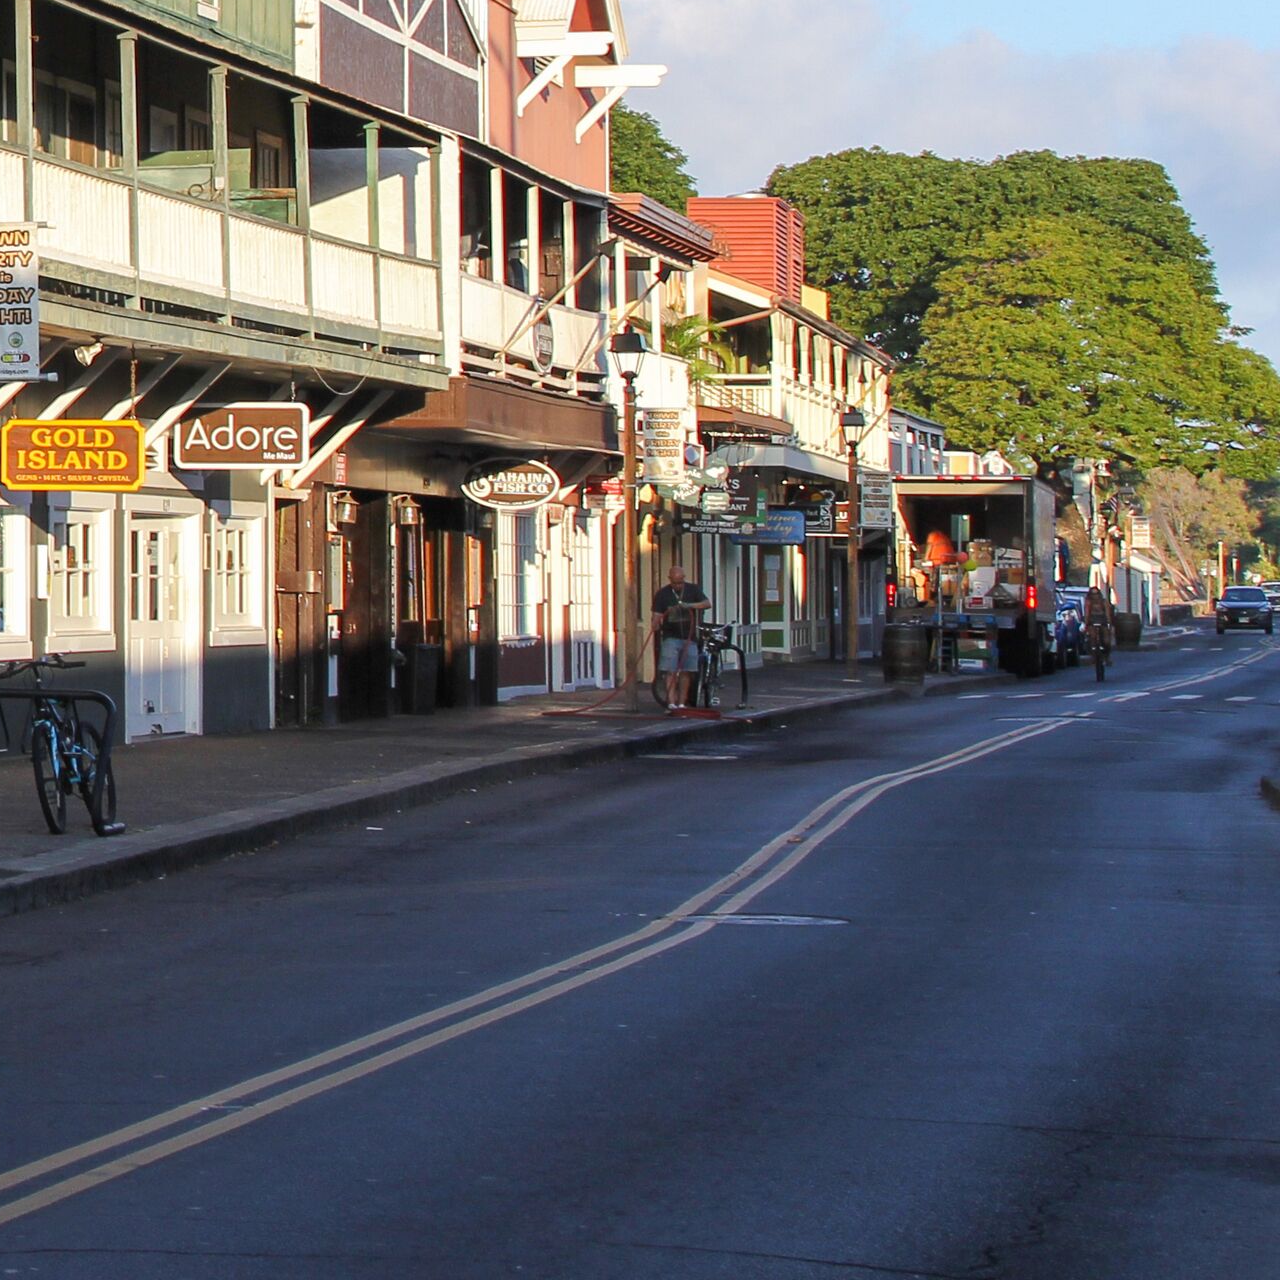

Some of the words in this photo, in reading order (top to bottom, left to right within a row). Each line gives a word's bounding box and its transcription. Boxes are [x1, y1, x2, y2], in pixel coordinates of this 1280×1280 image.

[31, 428, 115, 447] GOLD
[184, 413, 299, 451] Adore
[17, 450, 128, 470] ISLAND
[263, 452, 275, 460] Me
[276, 452, 296, 460] Maui
[493, 482, 526, 493] FISH
